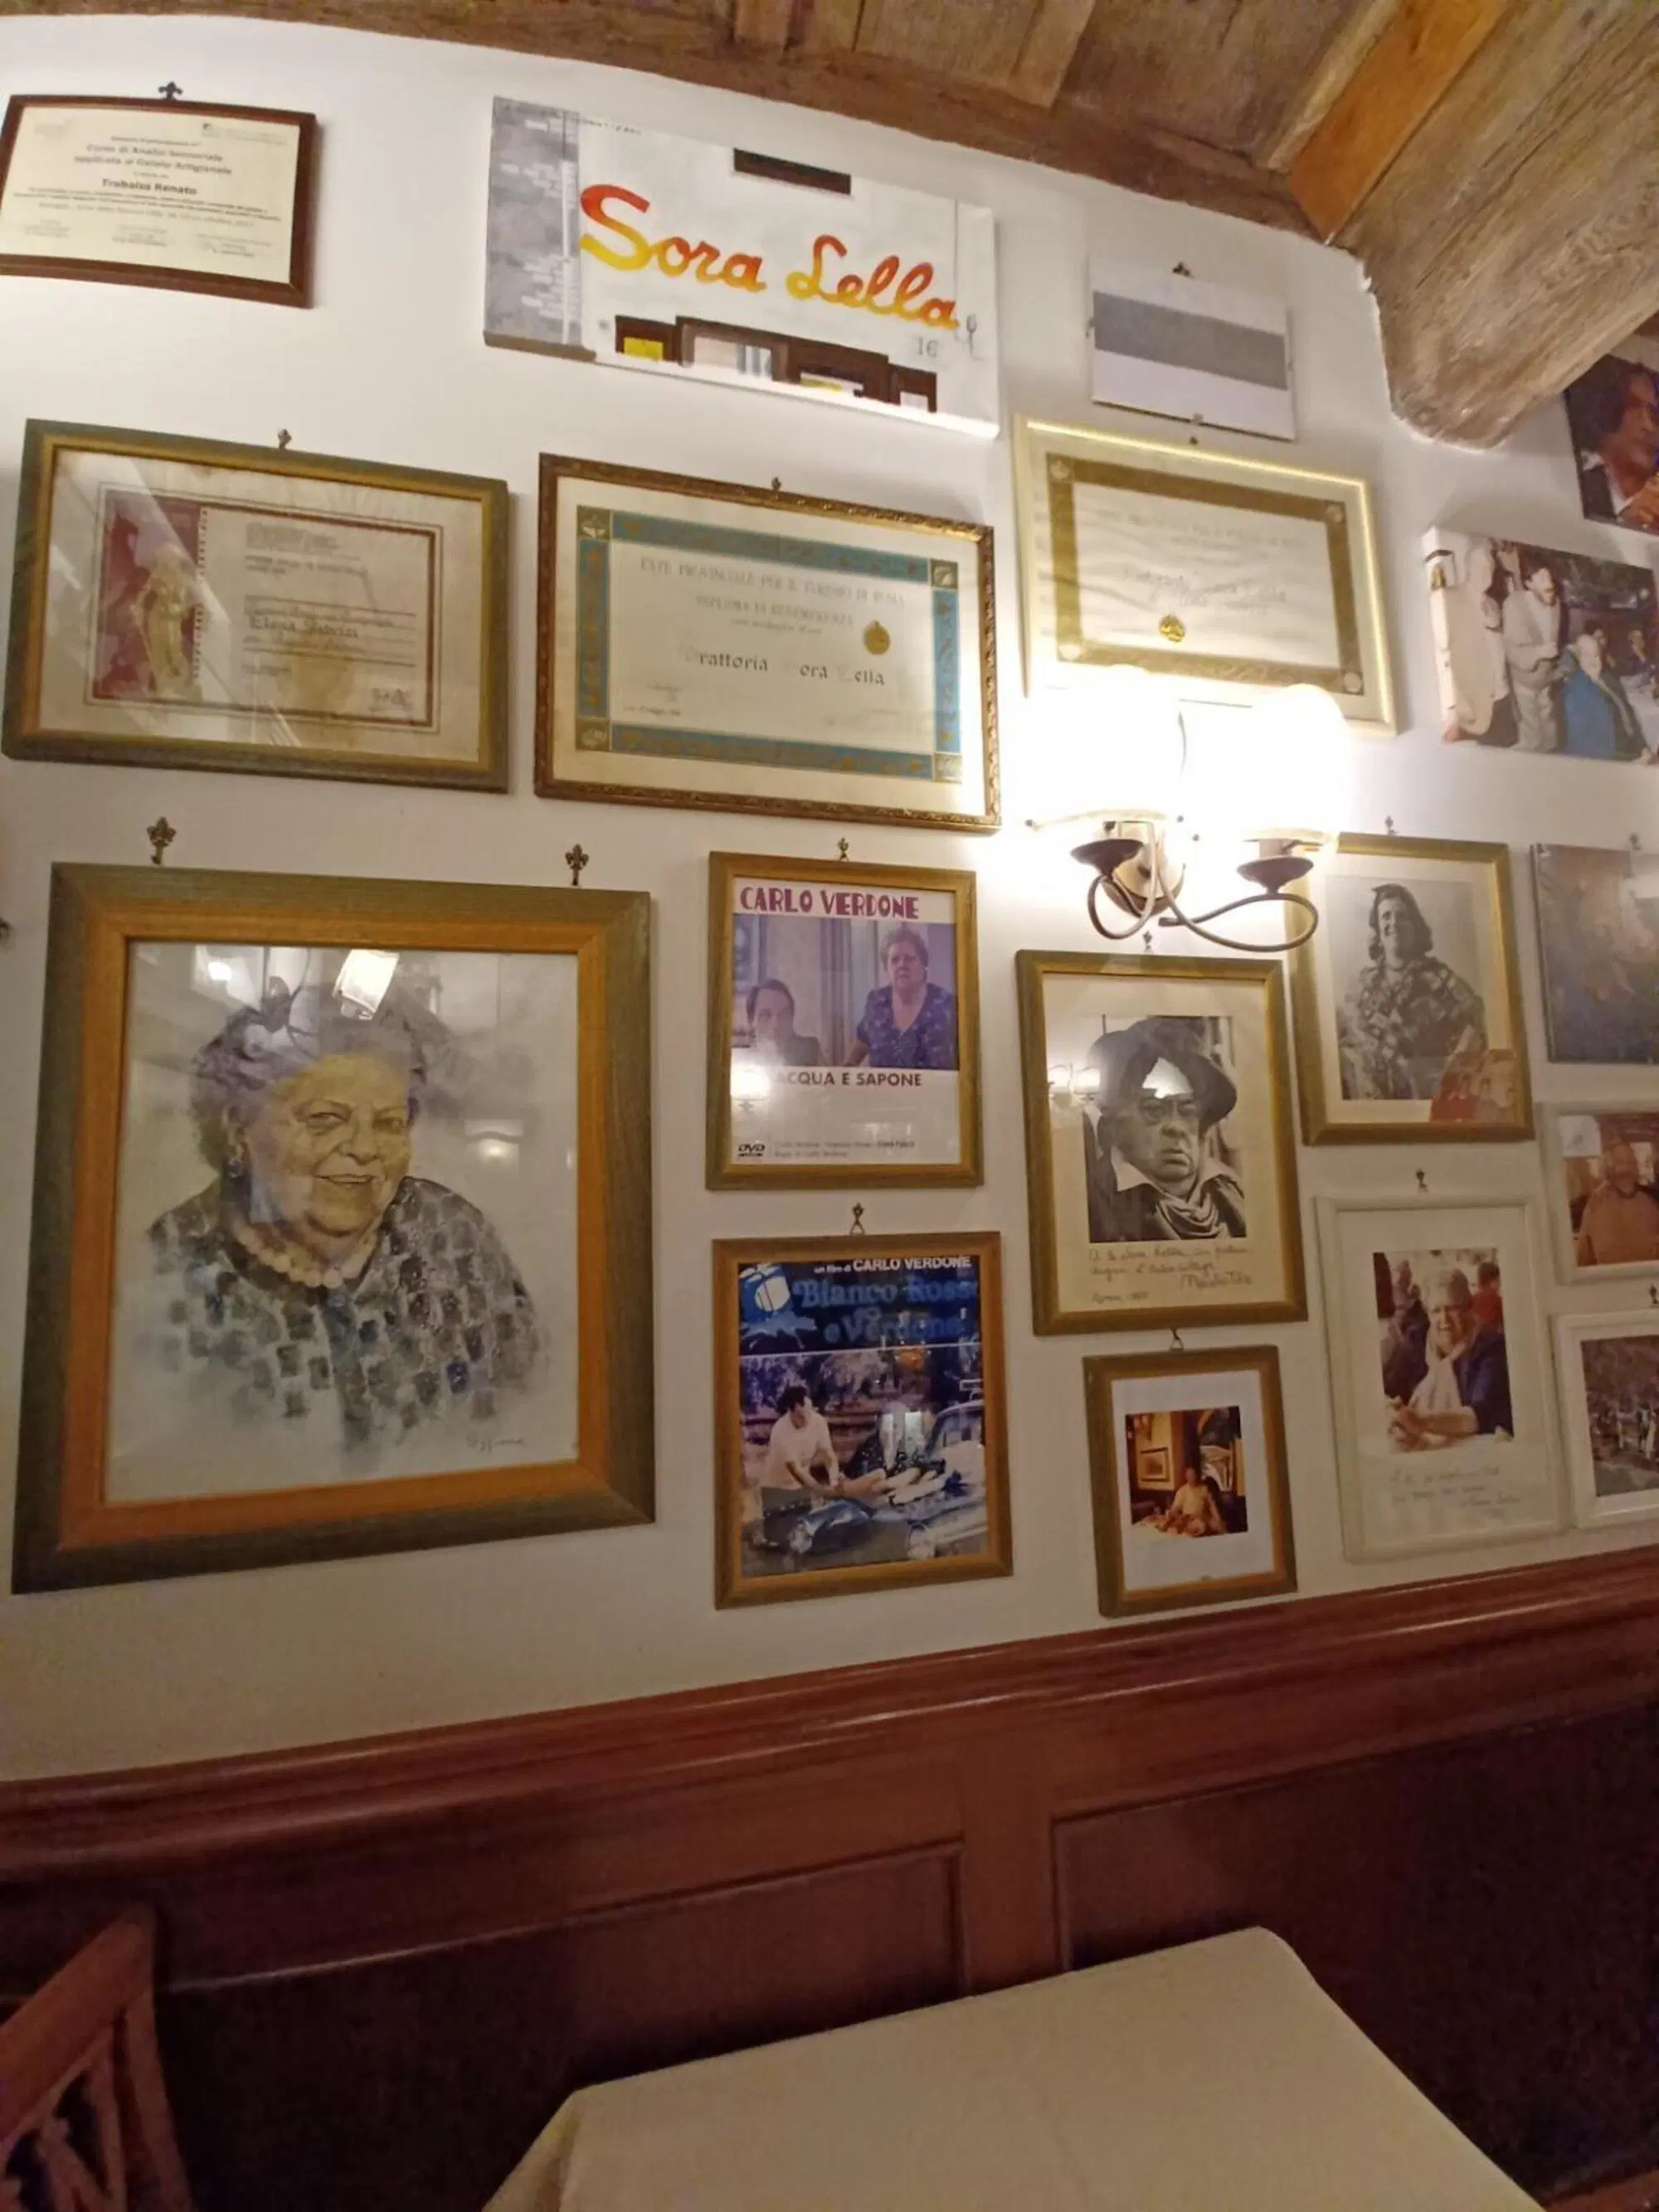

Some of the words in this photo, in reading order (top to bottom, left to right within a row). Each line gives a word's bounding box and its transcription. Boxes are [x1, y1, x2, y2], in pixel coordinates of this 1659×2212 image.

[580, 184, 766, 293] Sora
[785, 235, 961, 330] Lella
[740, 886, 814, 913] CARLO
[820, 890, 920, 919] VERDONE
[841, 1072, 851, 1086] E
[856, 1072, 923, 1087] SAPONE
[853, 1258, 901, 1272] CARLO
[904, 1256, 973, 1271] VERDONE
[791, 1277, 898, 1309] Bianco
